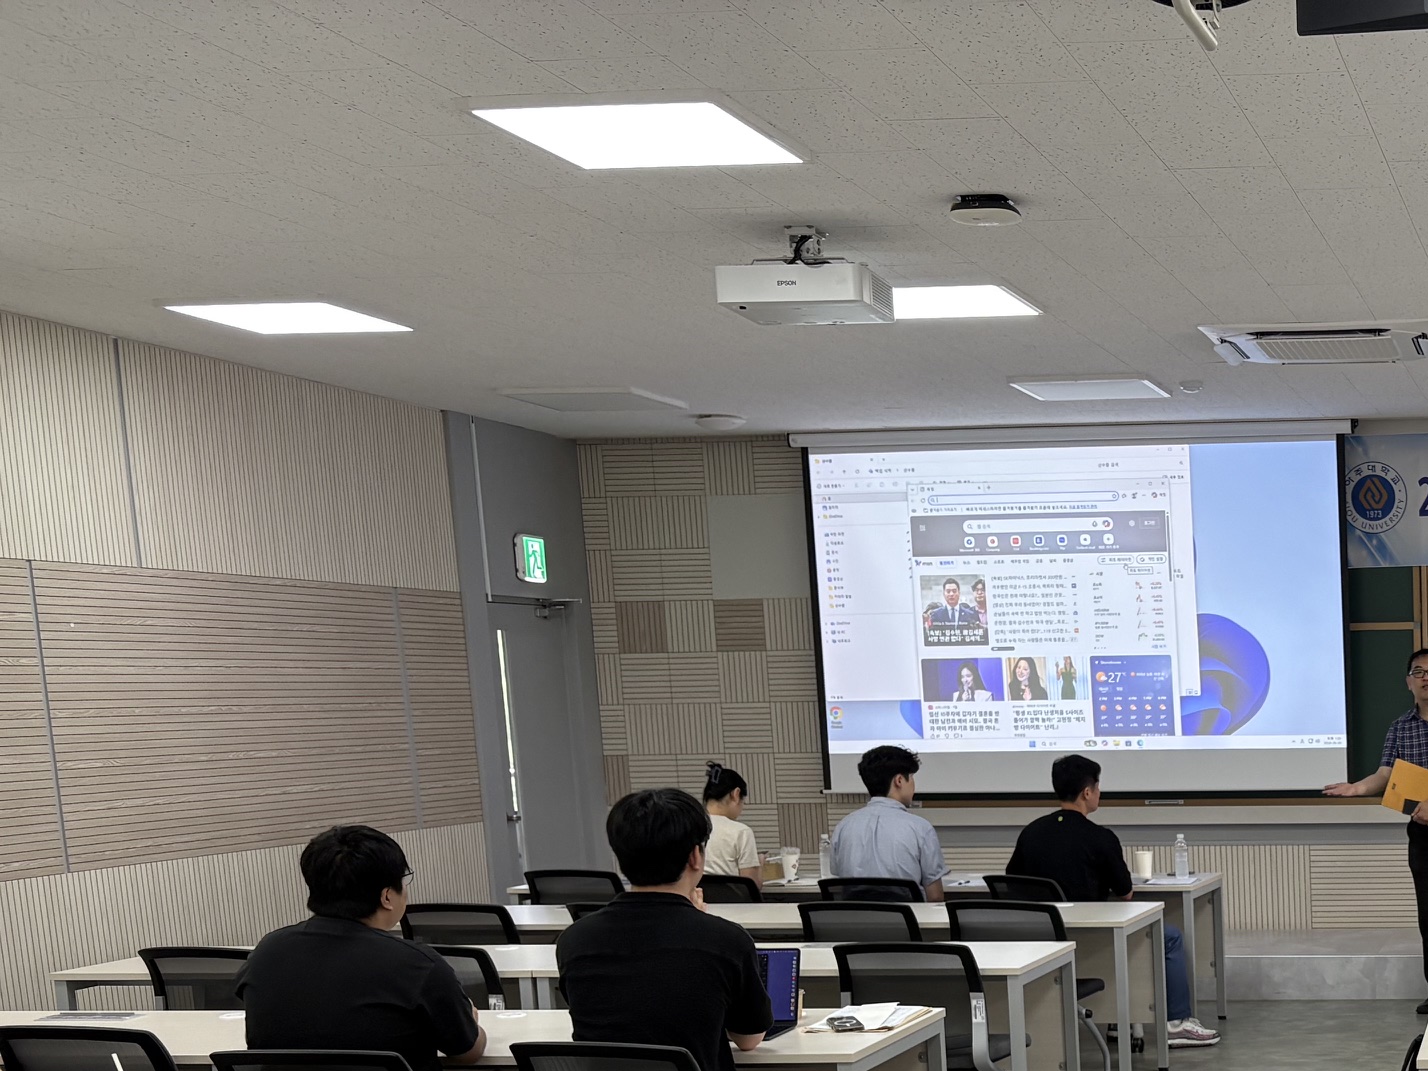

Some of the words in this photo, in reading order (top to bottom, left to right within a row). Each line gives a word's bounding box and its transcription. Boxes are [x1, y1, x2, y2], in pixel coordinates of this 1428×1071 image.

[1345, 464, 1400, 487] 아주대학교
[1361, 499, 1404, 531] UNIVERSITY
[1366, 510, 1382, 518] 1973
[1107, 672, 1122, 683] 27
